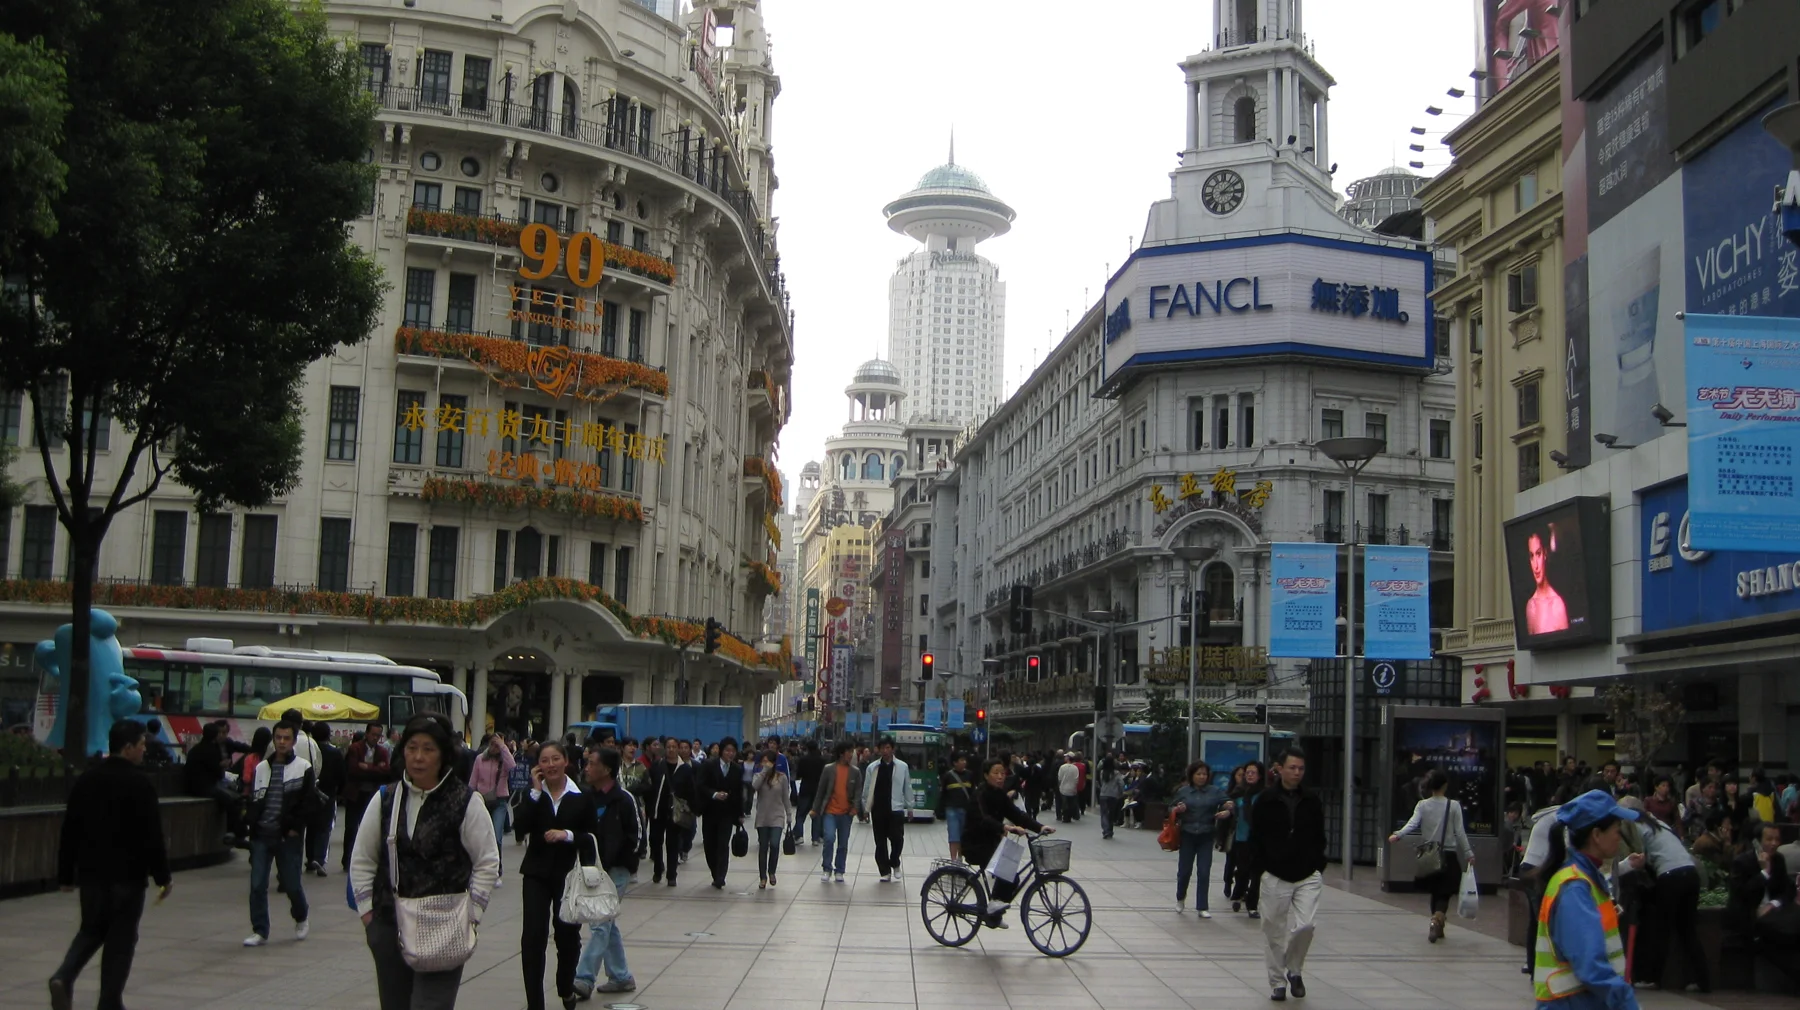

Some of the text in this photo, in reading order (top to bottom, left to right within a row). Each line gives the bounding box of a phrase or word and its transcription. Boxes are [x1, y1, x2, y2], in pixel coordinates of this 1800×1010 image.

[518, 223, 604, 289] 90
[1695, 215, 1767, 291] VICHY
[507, 285, 605, 317] YEARS
[1149, 276, 1275, 320] FANCL
[1702, 267, 1762, 306] LABORATOIRES
[505, 308, 601, 336] ANNIVERSARY
[1712, 337, 1800, 351] 第十届中国上海国际艺术
[1697, 386, 1730, 401] 艺术节
[1720, 411, 1744, 421] Daily
[400, 400, 668, 465] 永安百货九十周年店庆
[1149, 645, 1267, 669] 上海时装商店
[1144, 670, 1188, 681] SHANGHAI
[1193, 670, 1232, 681] ASHION
